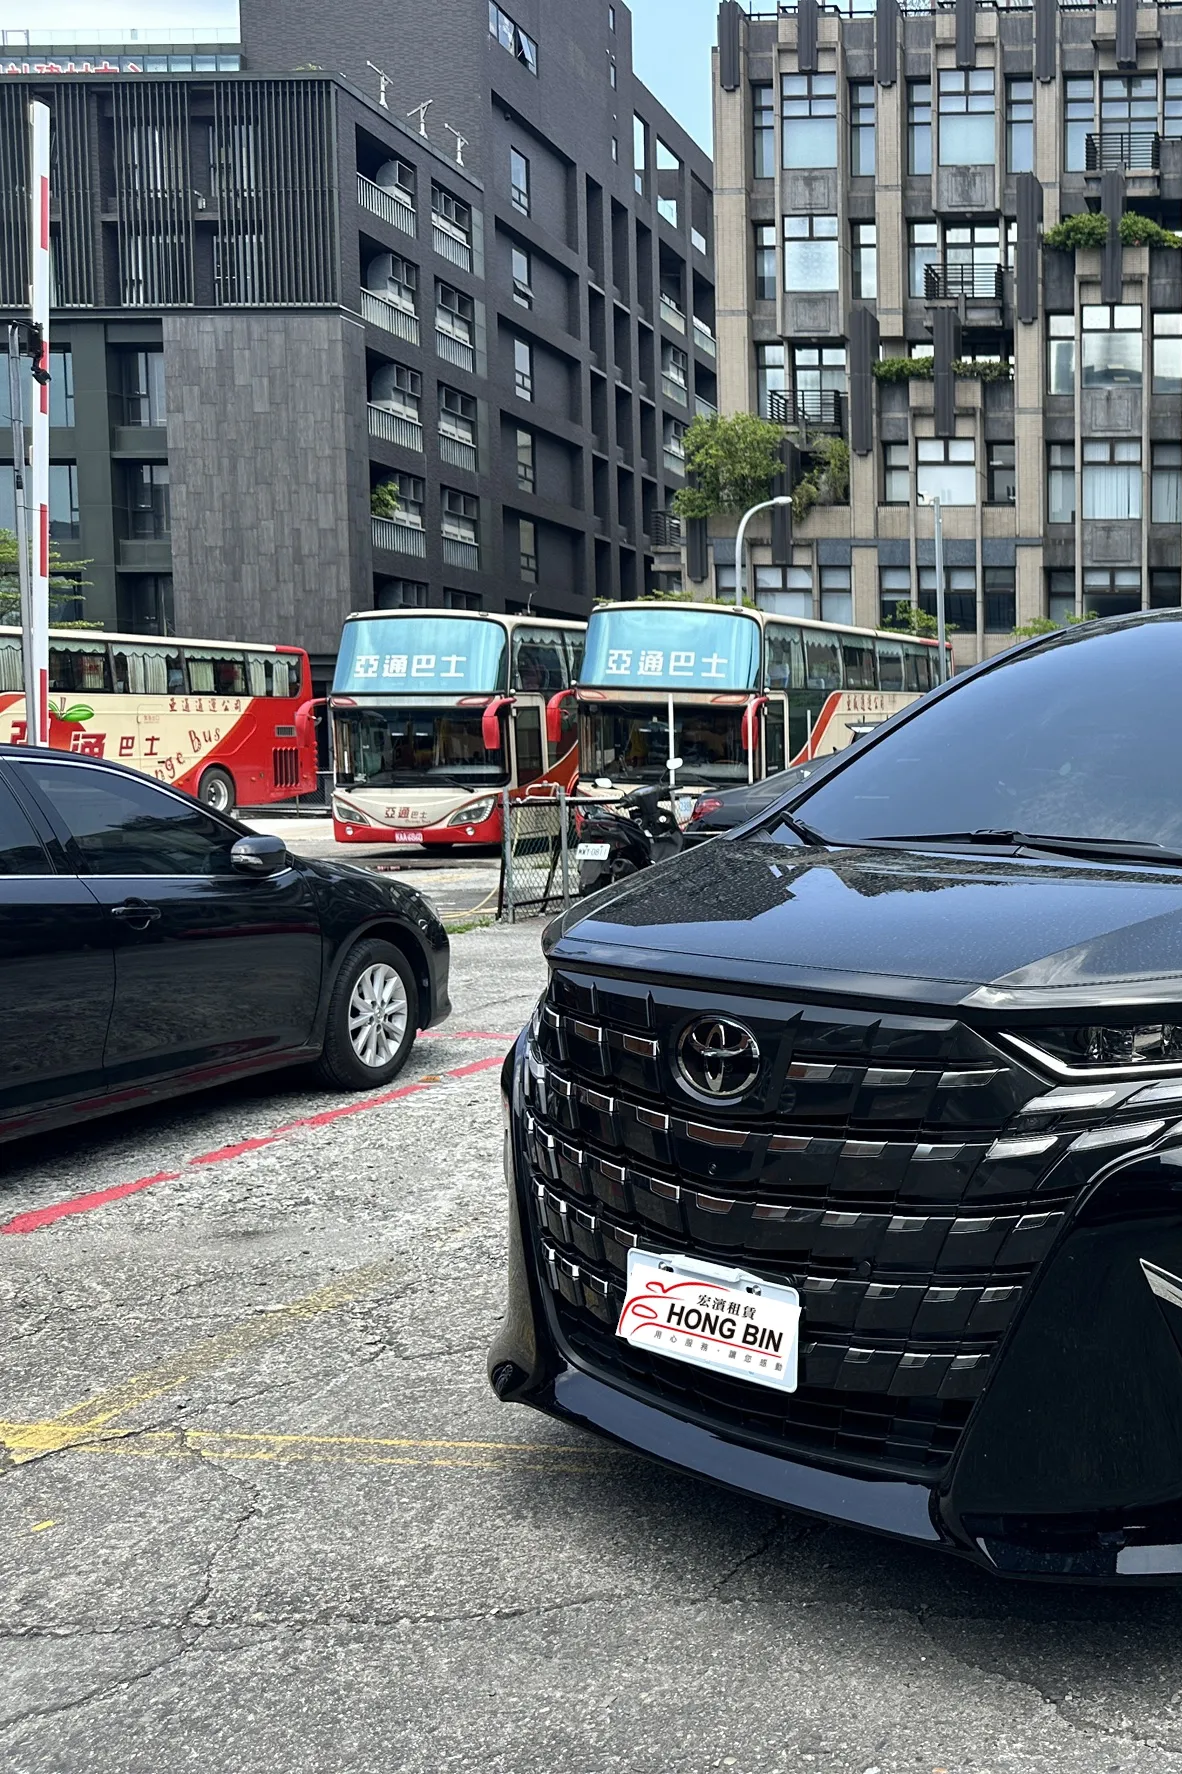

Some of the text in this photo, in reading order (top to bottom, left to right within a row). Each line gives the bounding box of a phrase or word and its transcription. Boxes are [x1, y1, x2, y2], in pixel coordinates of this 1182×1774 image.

[353, 654, 467, 678] 亞通巴士
[605, 649, 728, 678] 亞通巴士
[188, 727, 221, 753] Bus
[384, 806, 428, 819] 亞通巴士
[696, 1294, 757, 1320] 宏濱租賃
[666, 1303, 784, 1353] HONG BIN
